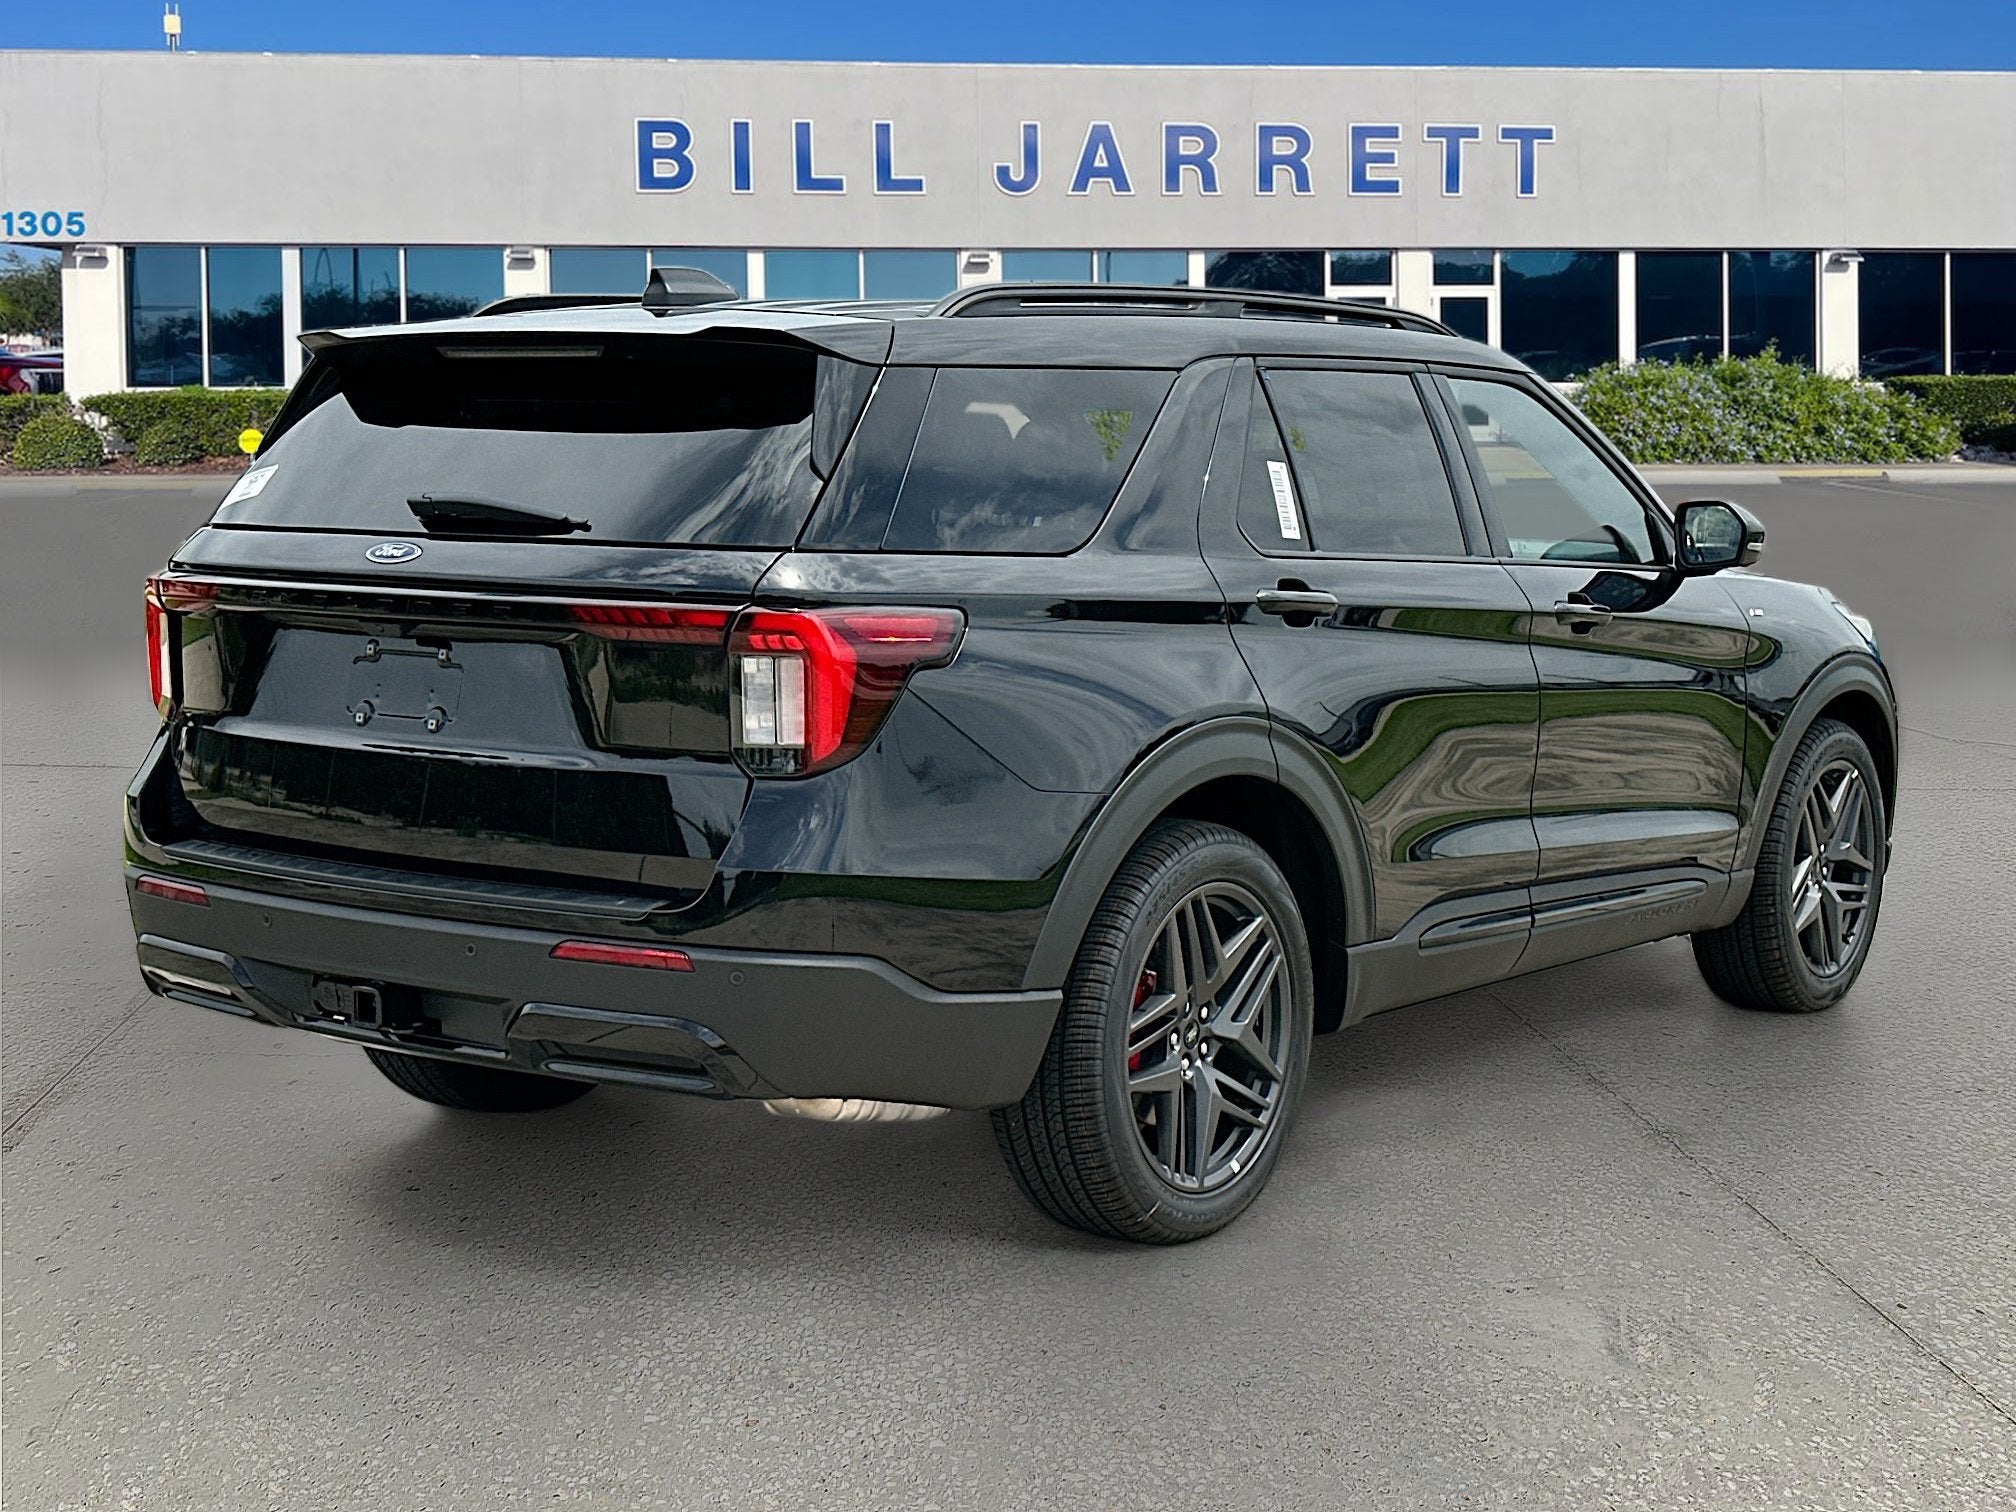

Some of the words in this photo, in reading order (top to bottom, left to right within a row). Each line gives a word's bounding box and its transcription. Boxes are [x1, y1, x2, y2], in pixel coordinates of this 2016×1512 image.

[634, 117, 926, 194] BILL
[992, 120, 1556, 197] JARRETT
[1, 210, 86, 237] 1305
